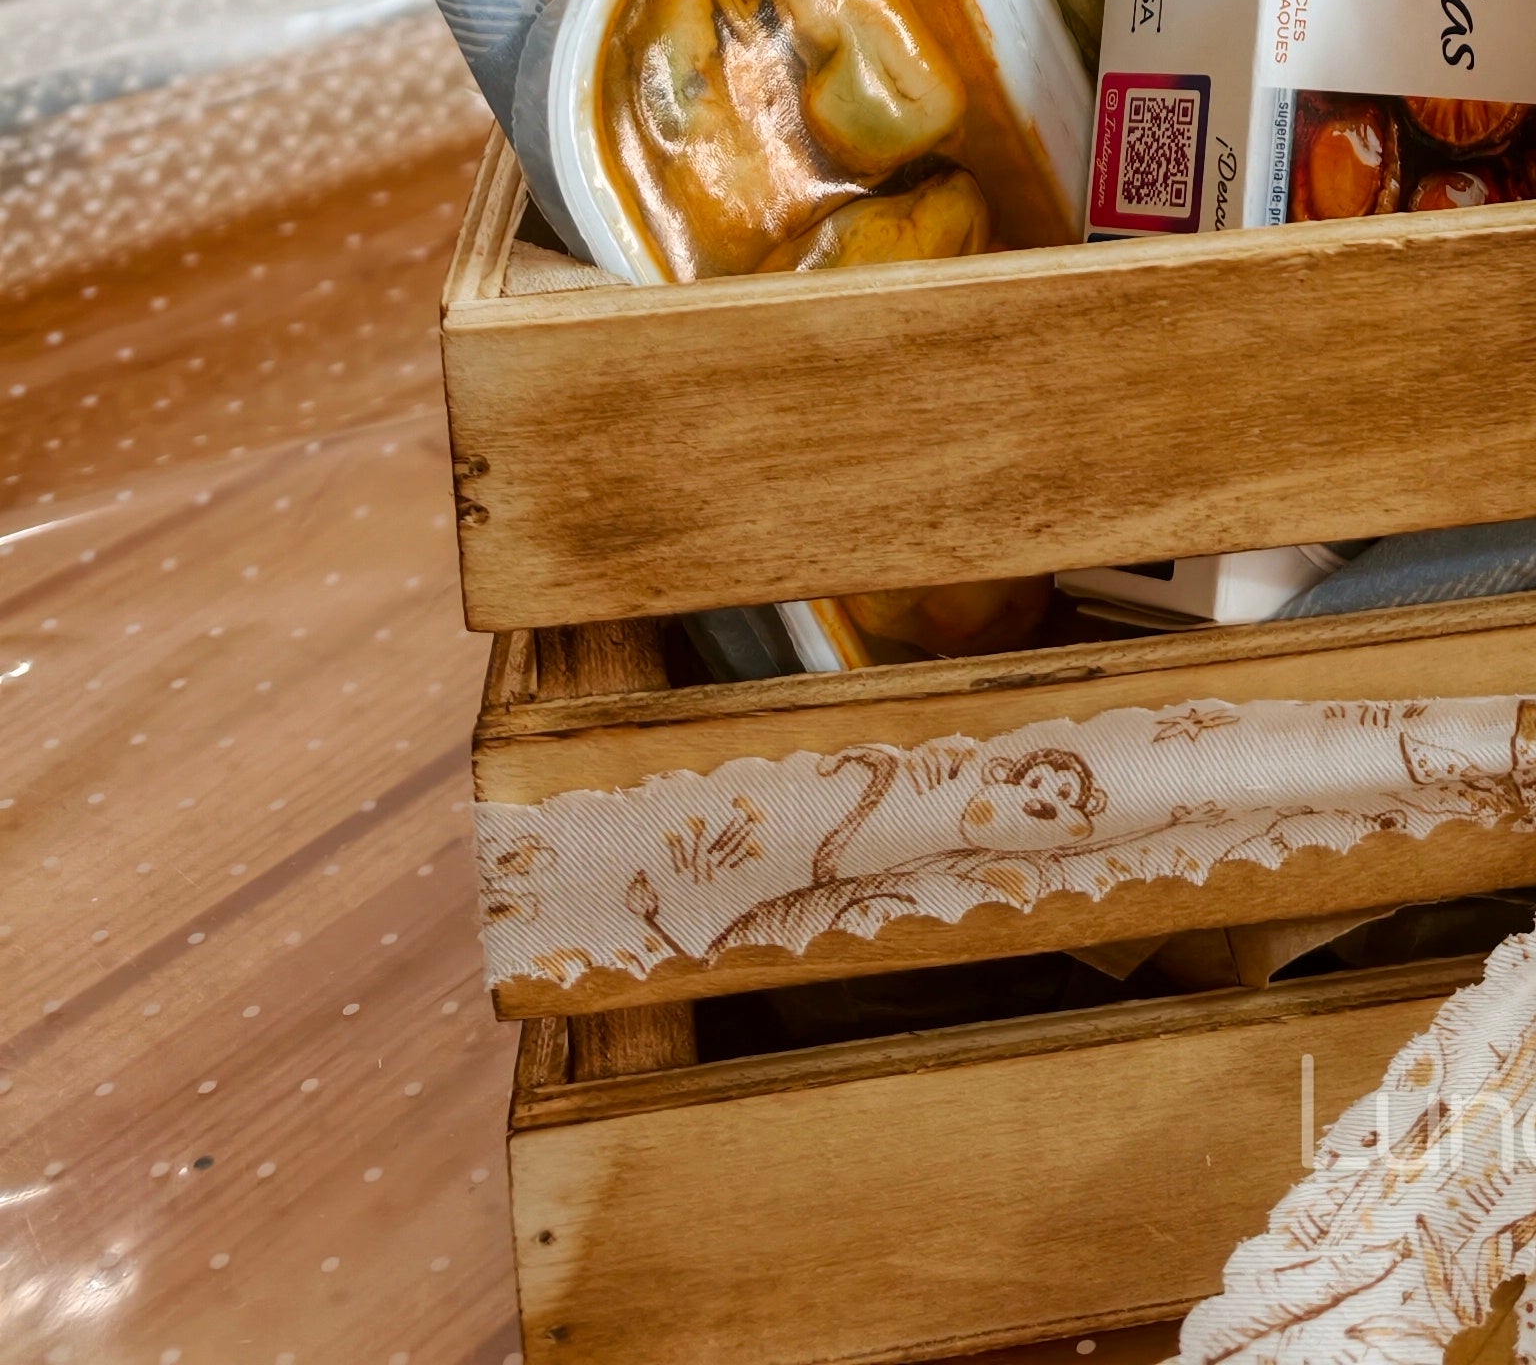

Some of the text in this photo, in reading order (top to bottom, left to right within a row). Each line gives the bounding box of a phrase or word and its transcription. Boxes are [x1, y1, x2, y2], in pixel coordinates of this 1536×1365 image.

[1096, 113, 1116, 208] Instagram
[1273, 101, 1289, 181] sugerencia
[1271, 185, 1286, 203] de
